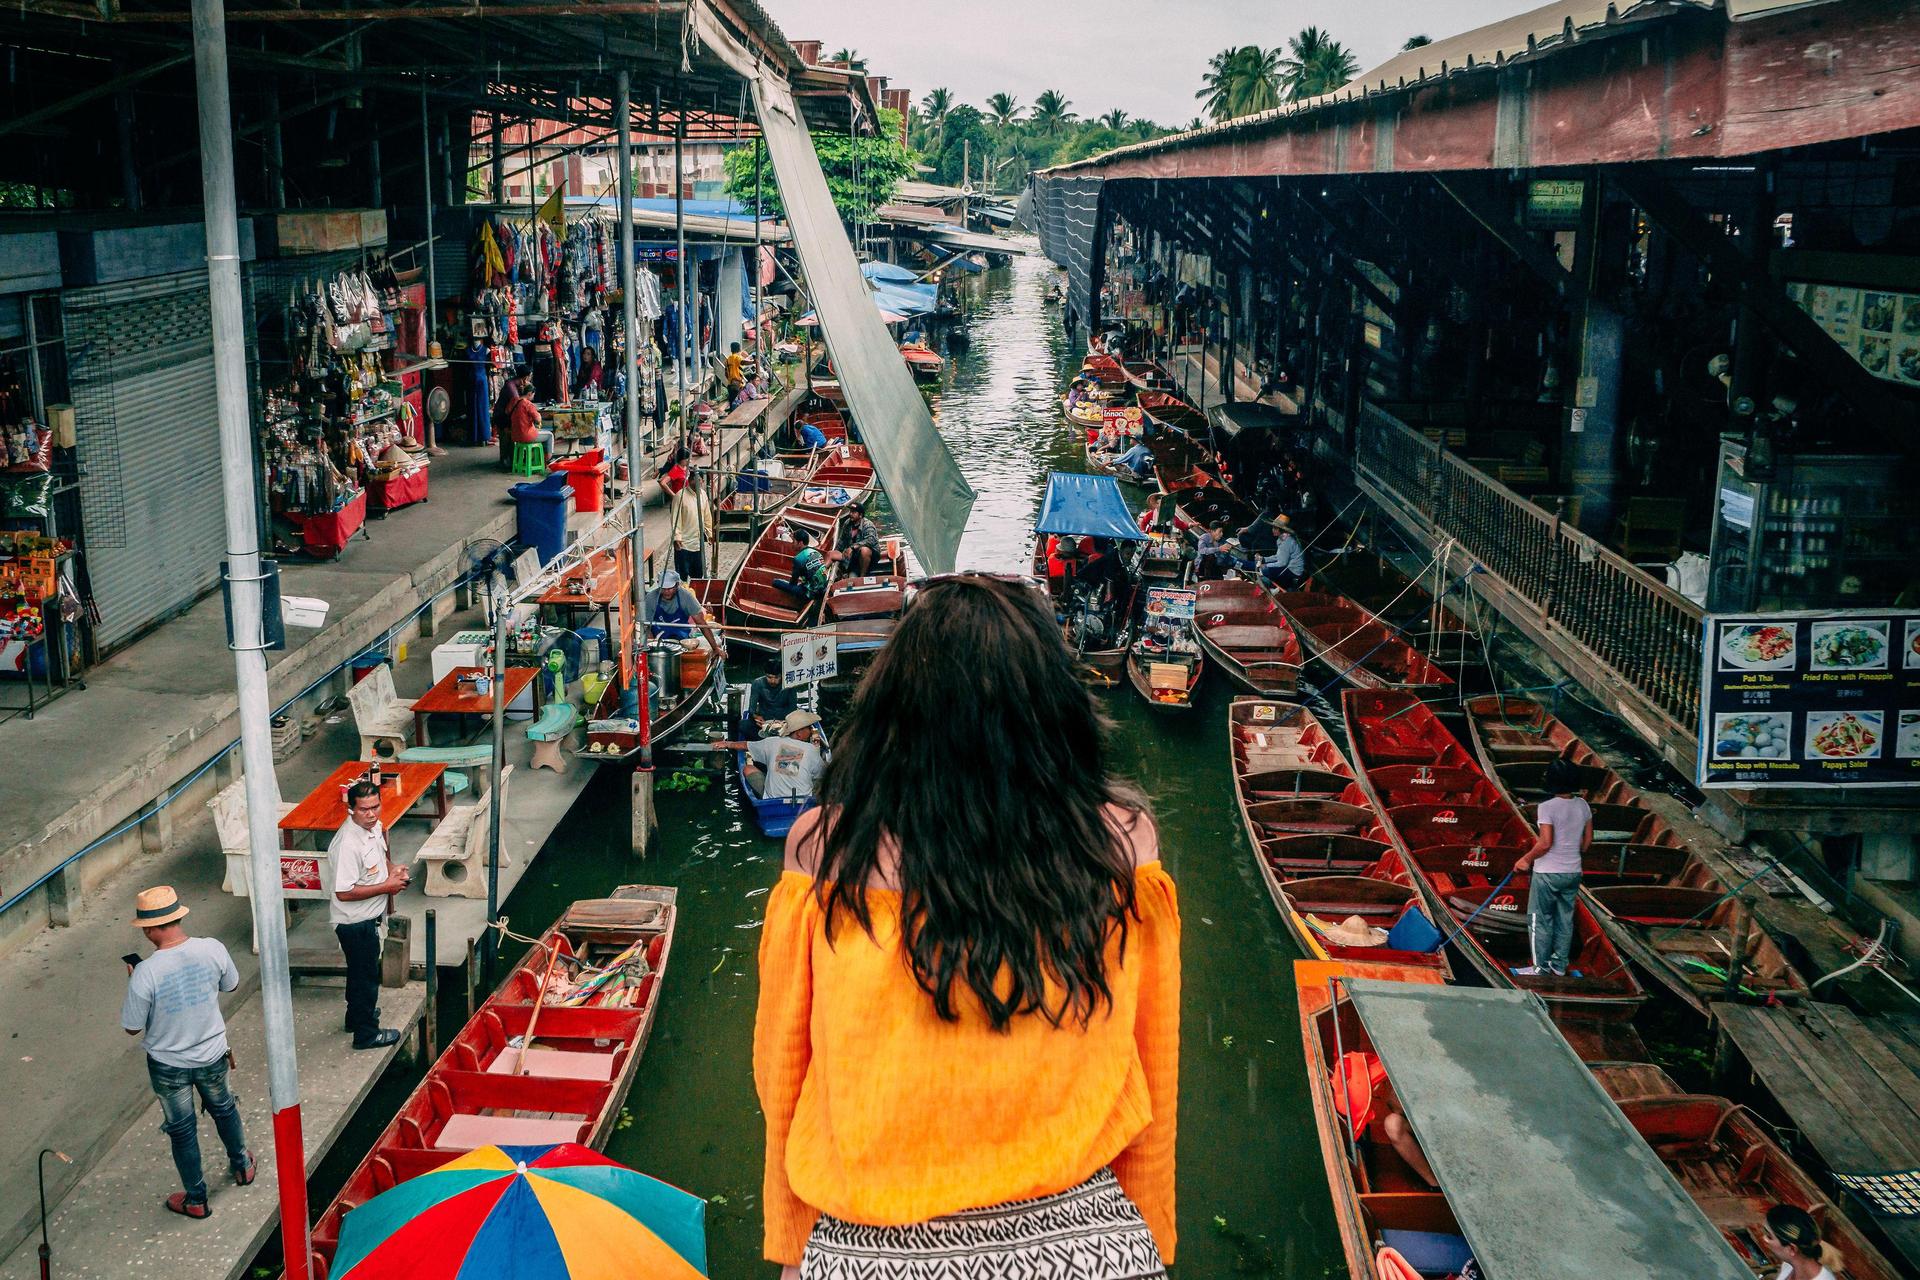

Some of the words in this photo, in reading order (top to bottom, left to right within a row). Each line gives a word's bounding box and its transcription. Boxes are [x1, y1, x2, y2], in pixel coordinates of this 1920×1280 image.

[785, 661, 836, 684] 椰子冰淇淋
[1742, 674, 1756, 682] Pad
[1758, 674, 1774, 682] Thai
[1802, 673, 1821, 681] Fried
[1822, 673, 1839, 681] Rice
[1840, 673, 1857, 681] with
[1858, 673, 1894, 681] Pineapple
[1735, 762, 1752, 770] Soup
[1822, 761, 1847, 769] Papaya
[1849, 760, 1868, 768] Salad
